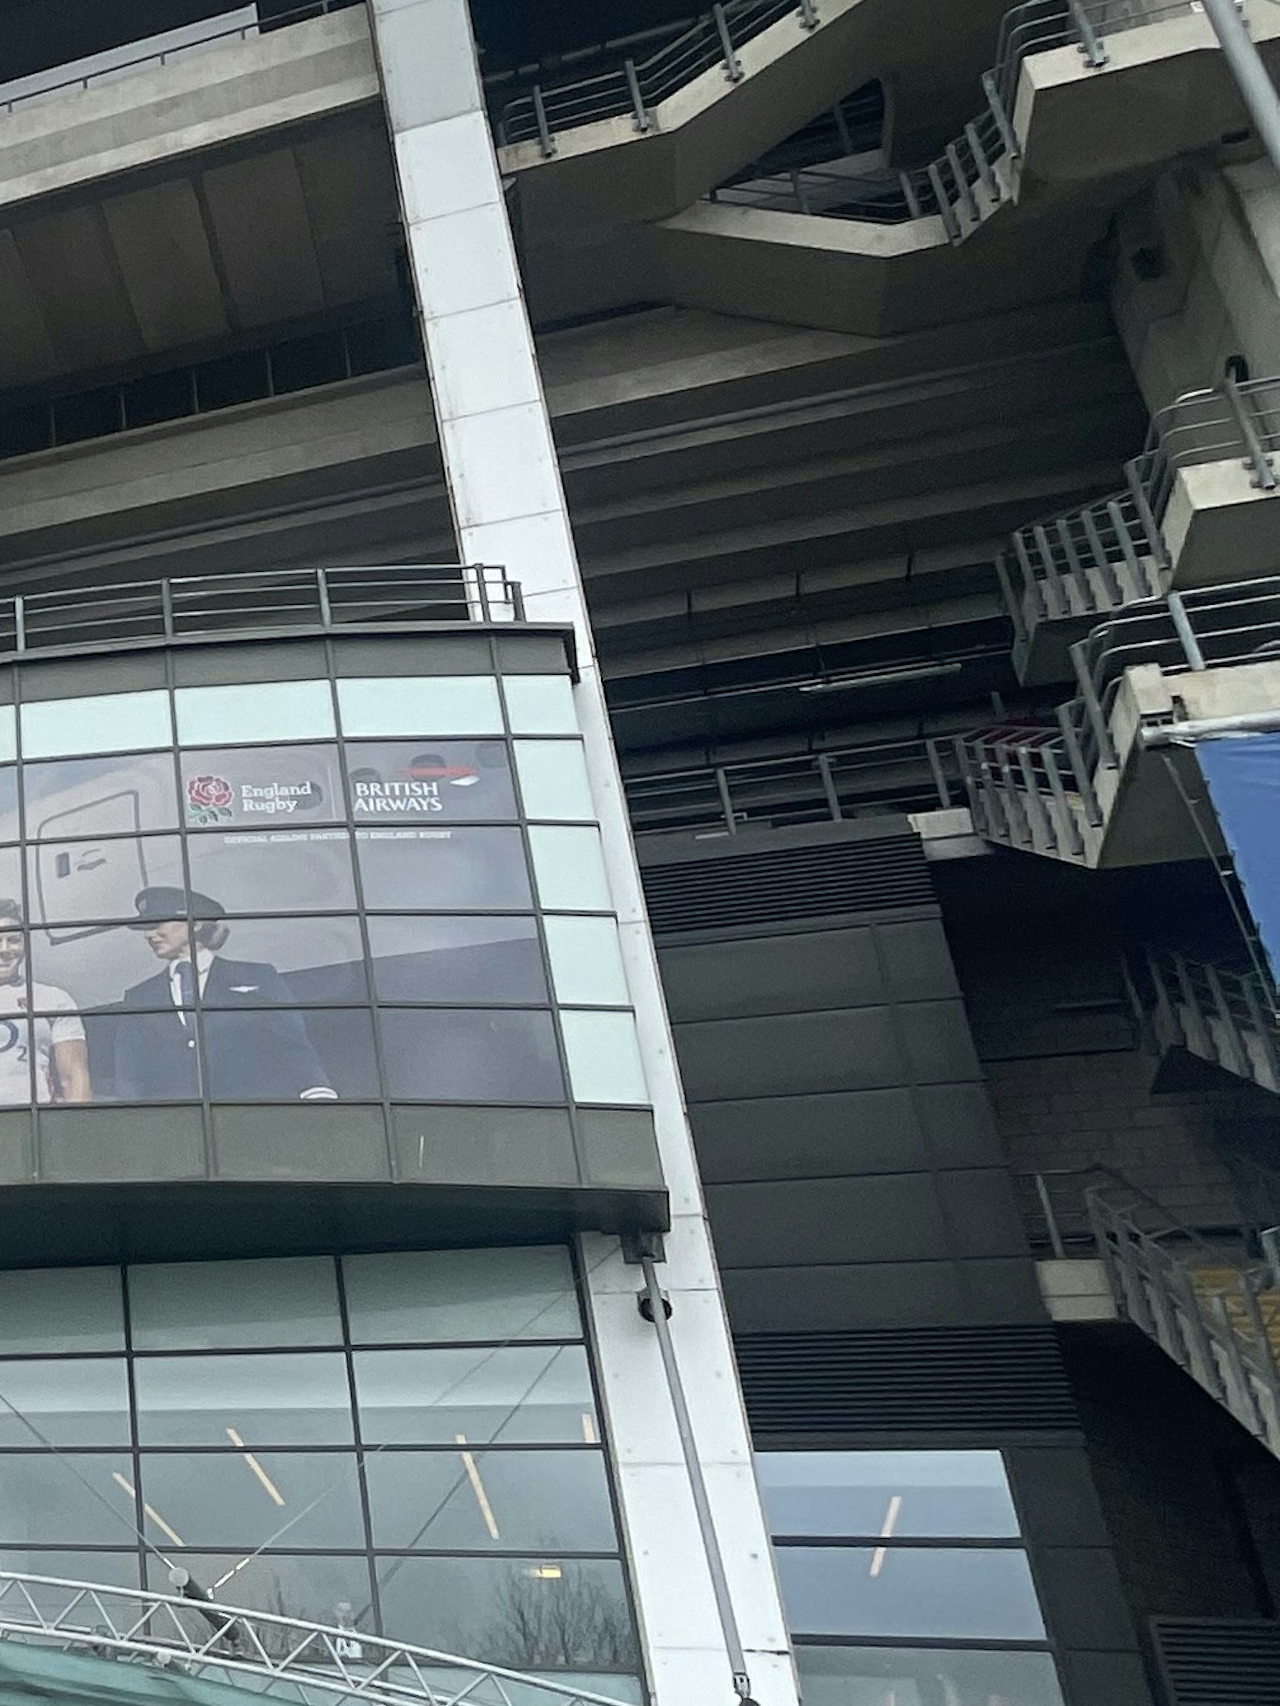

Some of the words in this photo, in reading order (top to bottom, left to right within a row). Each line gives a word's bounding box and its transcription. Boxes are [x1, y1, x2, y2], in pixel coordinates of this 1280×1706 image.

[241, 781, 312, 799] England
[356, 782, 438, 796] BRITISH
[242, 798, 298, 813] Rugby
[354, 797, 443, 812] AIRWAYS
